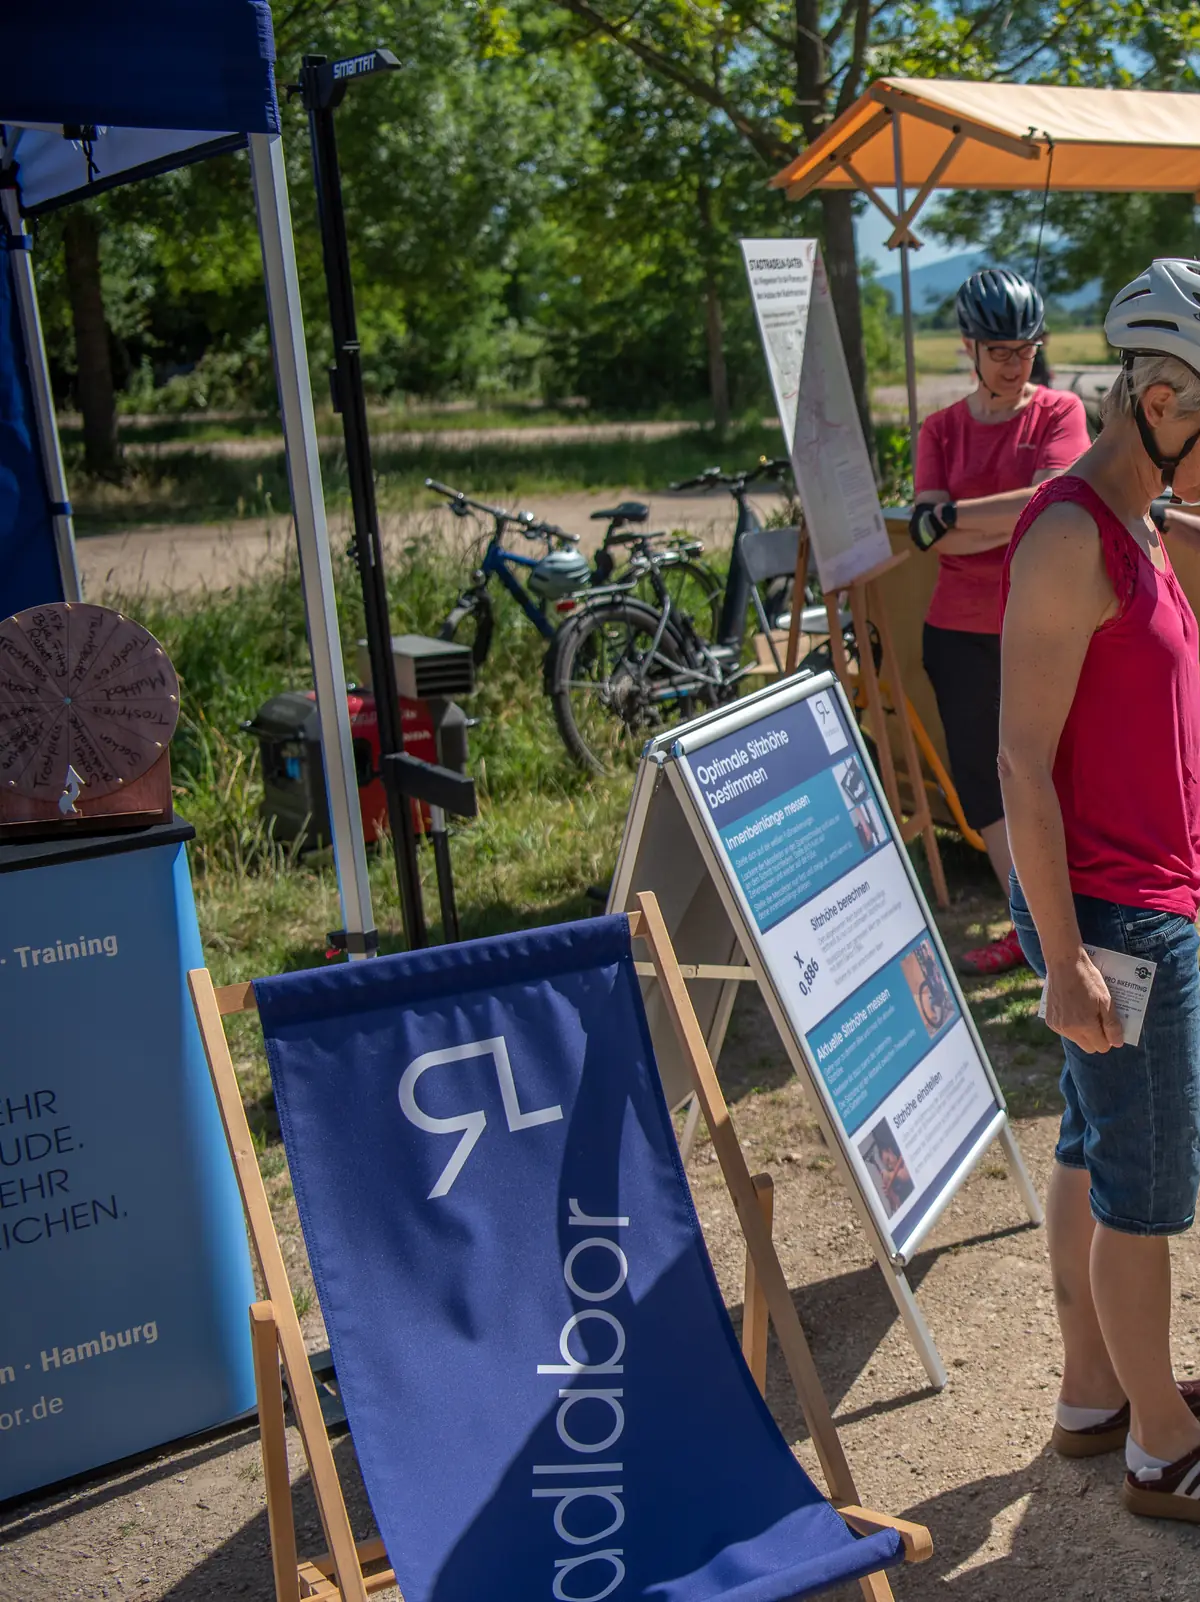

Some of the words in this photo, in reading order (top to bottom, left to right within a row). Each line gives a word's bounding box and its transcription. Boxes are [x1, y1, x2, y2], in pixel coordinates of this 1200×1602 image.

[696, 746, 750, 785] Optimale
[747, 729, 789, 759] Sitzhöhe
[706, 766, 768, 809] bestimmen
[725, 809, 785, 850] Innenbeinlänge
[784, 794, 810, 817] messen
[810, 904, 838, 931] Sitzhöhe
[836, 880, 870, 913] berechnen
[13, 935, 118, 968] Training
[798, 956, 820, 997] 0,886
[817, 1028, 843, 1062] Aktuelle
[841, 1010, 868, 1041] Sitzhöhe
[866, 987, 891, 1015] messen
[893, 1096, 918, 1129] Sitzhöhe
[916, 1070, 943, 1106] einstellen
[0, 1194, 127, 1250] ICHEN.
[40, 1320, 158, 1372] Hamburg
